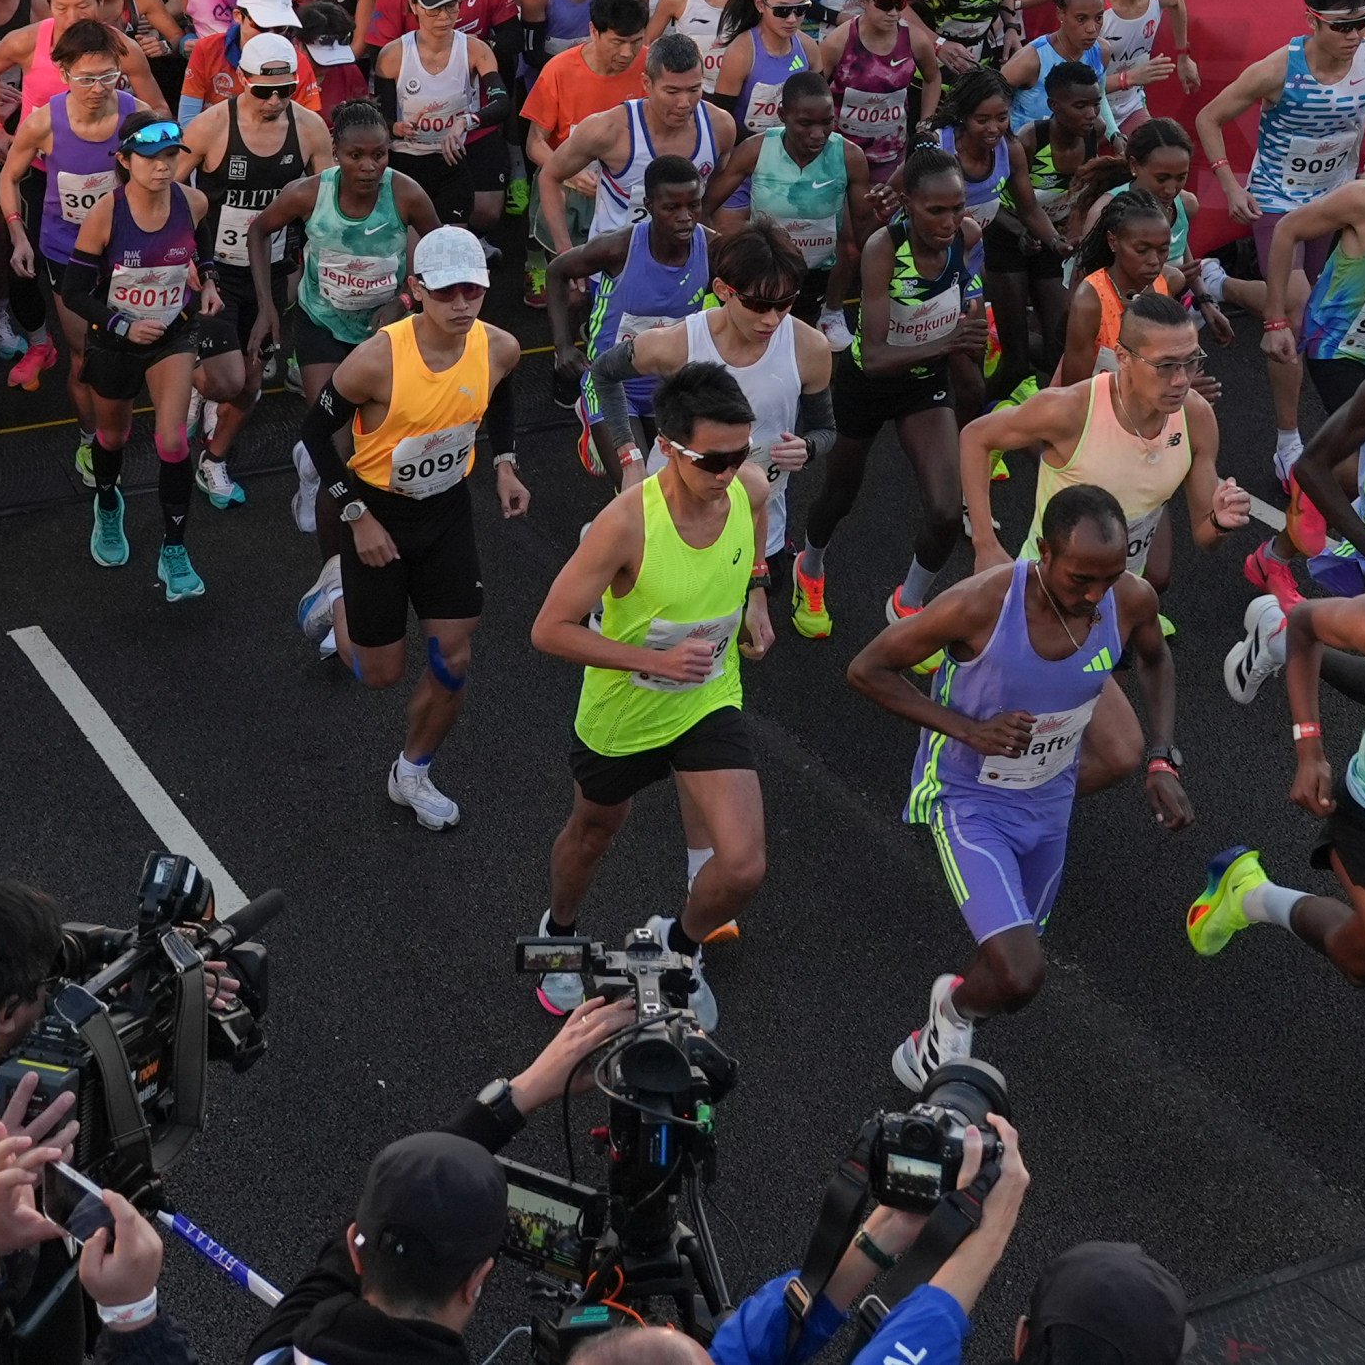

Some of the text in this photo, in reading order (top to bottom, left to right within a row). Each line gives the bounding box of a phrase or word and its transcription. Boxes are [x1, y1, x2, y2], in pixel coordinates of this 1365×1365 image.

[846, 105, 901, 123] 70040
[1291, 150, 1349, 174] 9097
[124, 258, 141, 267] ELITE
[115, 287, 180, 308] 30012
[887, 310, 958, 335] Chepkurui
[399, 444, 469, 482] 9095
[1038, 756, 1046, 767] 4
